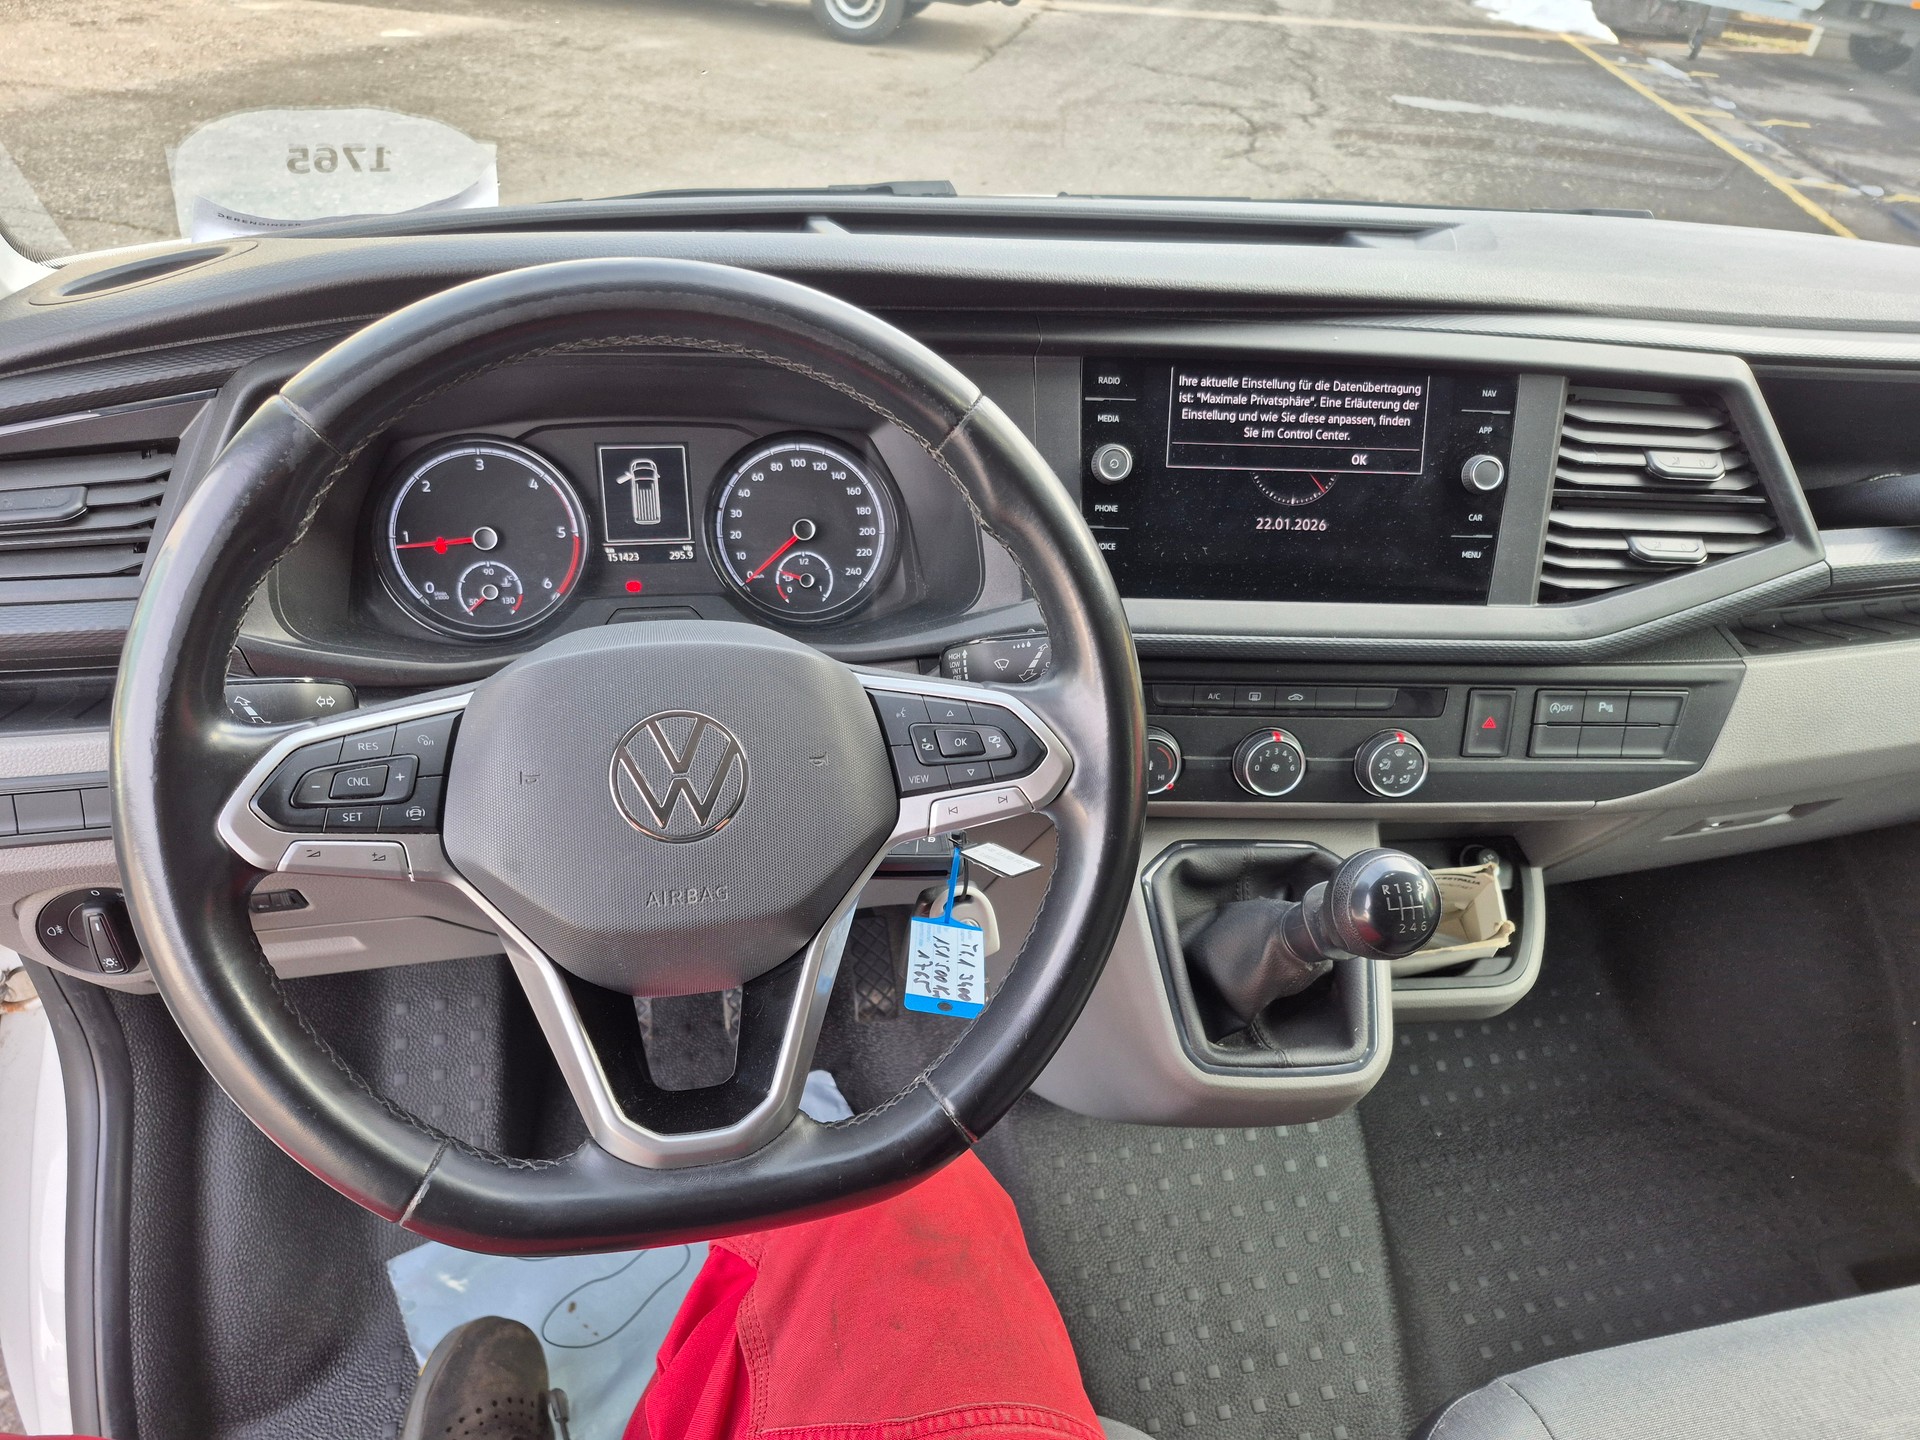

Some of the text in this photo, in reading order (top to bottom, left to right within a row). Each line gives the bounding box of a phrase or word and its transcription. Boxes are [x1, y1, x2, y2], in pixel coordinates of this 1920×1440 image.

[1098, 376, 1121, 385] RADIO
[1179, 374, 1422, 396] Ihre aktuelle Einstellung für die Datenübertragung
[1482, 389, 1498, 398] NAV
[1178, 392, 1420, 412] ist: "Maximale Privatsphäre". Eine Erläuterung der
[1097, 414, 1120, 423] MEDIA
[1181, 408, 1411, 428] Einstellung und wie Sie diese anpassen, finden
[1243, 426, 1351, 441] Sie im Control Center.
[1478, 426, 1493, 434] APP
[790, 459, 806, 467] 100
[1351, 453, 1369, 466] OK
[475, 458, 485, 471] 3
[770, 463, 783, 472] 80
[813, 462, 827, 471] 120
[751, 473, 764, 482] 60
[831, 472, 846, 480] 140
[421, 480, 431, 493] 2
[529, 479, 539, 490] 4
[738, 488, 751, 498] 40
[847, 487, 861, 496] 160
[856, 507, 871, 515] 180
[1094, 504, 1119, 513] PHONE
[730, 509, 742, 518] 30
[1468, 513, 1483, 522] CAR
[1255, 517, 1327, 532] 22.01.2026
[557, 526, 566, 538] 5
[730, 531, 742, 539] 20
[859, 527, 876, 536] 200
[403, 531, 409, 543] 1
[607, 551, 694, 562] 151423 295.9
[736, 552, 746, 560] 10
[856, 549, 872, 557] 220
[1461, 550, 1482, 559] MENU
[798, 558, 809, 566] 1/2
[483, 568, 495, 576] 90
[845, 567, 862, 576] 240
[543, 577, 552, 589] 6
[425, 582, 435, 594] 0
[502, 597, 516, 605] 130
[948, 652, 961, 661] HIGH
[950, 661, 960, 669] LOW
[1208, 692, 1221, 701] A/C
[358, 742, 379, 751] RES
[954, 738, 967, 747] OK
[347, 777, 371, 787] CNCL
[908, 775, 929, 784] VIEW
[342, 812, 363, 822] SET
[1382, 884, 1391, 895] R
[1394, 883, 1401, 893] 1
[1405, 882, 1413, 893] 3
[646, 886, 729, 908] AIRBAG
[1400, 922, 1427, 934] 2 4 6
